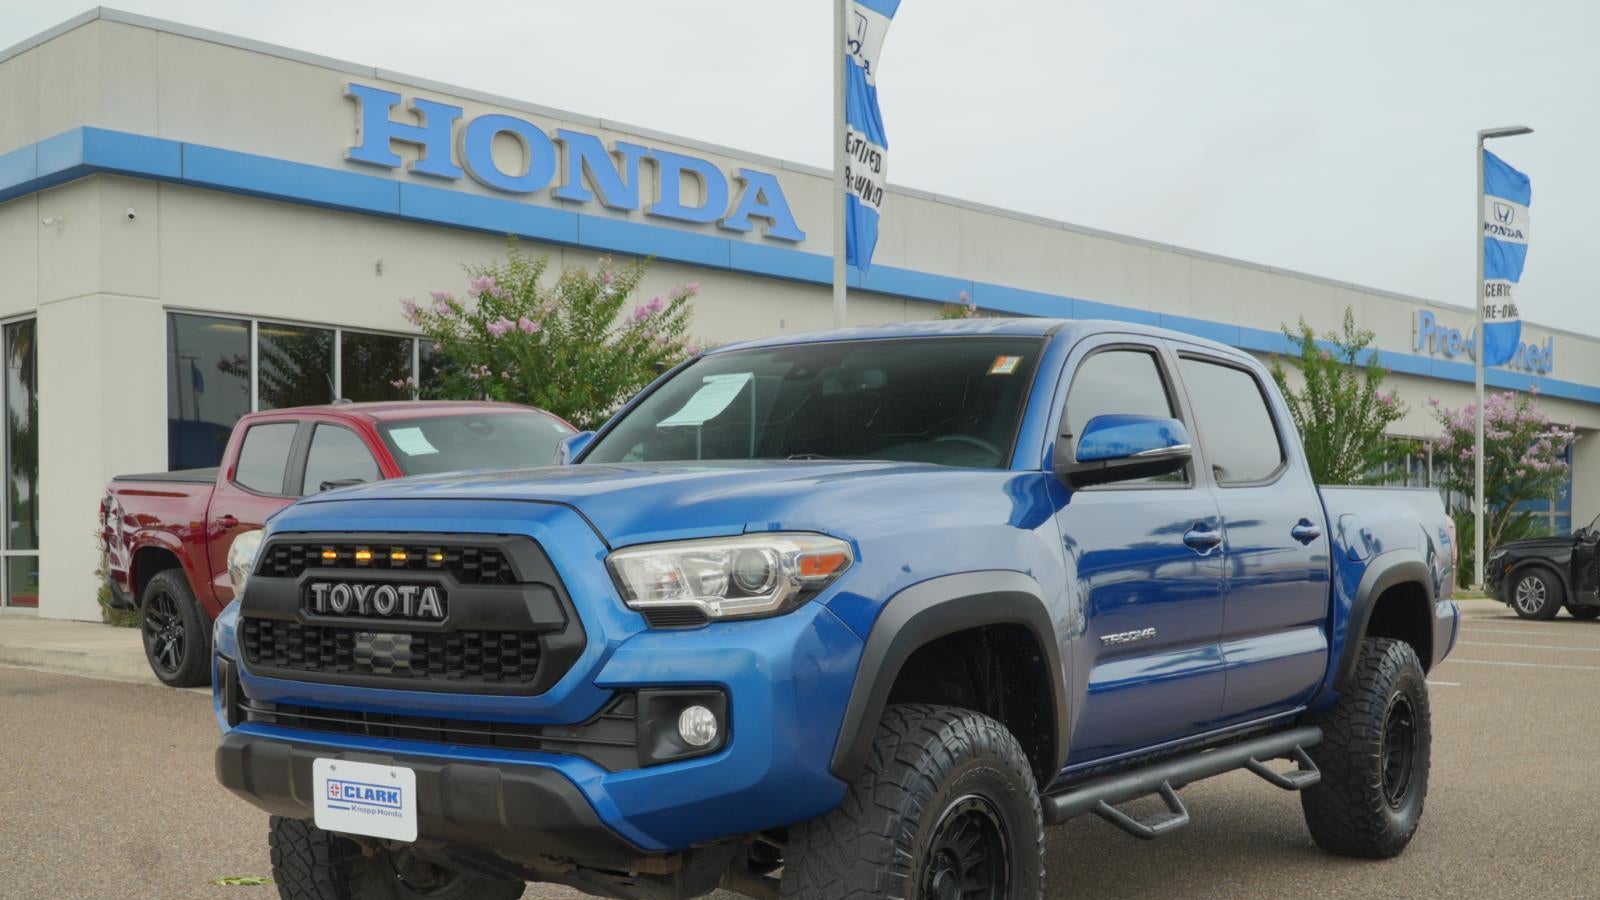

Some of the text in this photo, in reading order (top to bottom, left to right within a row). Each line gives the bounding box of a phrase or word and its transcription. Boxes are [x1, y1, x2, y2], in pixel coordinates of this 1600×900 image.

[345, 83, 806, 242] HONDA
[1414, 308, 1554, 374] Pre-ned
[311, 583, 444, 618] TOYOTA
[344, 786, 399, 804] CLARK
[351, 804, 403, 818] Knapp Honda
